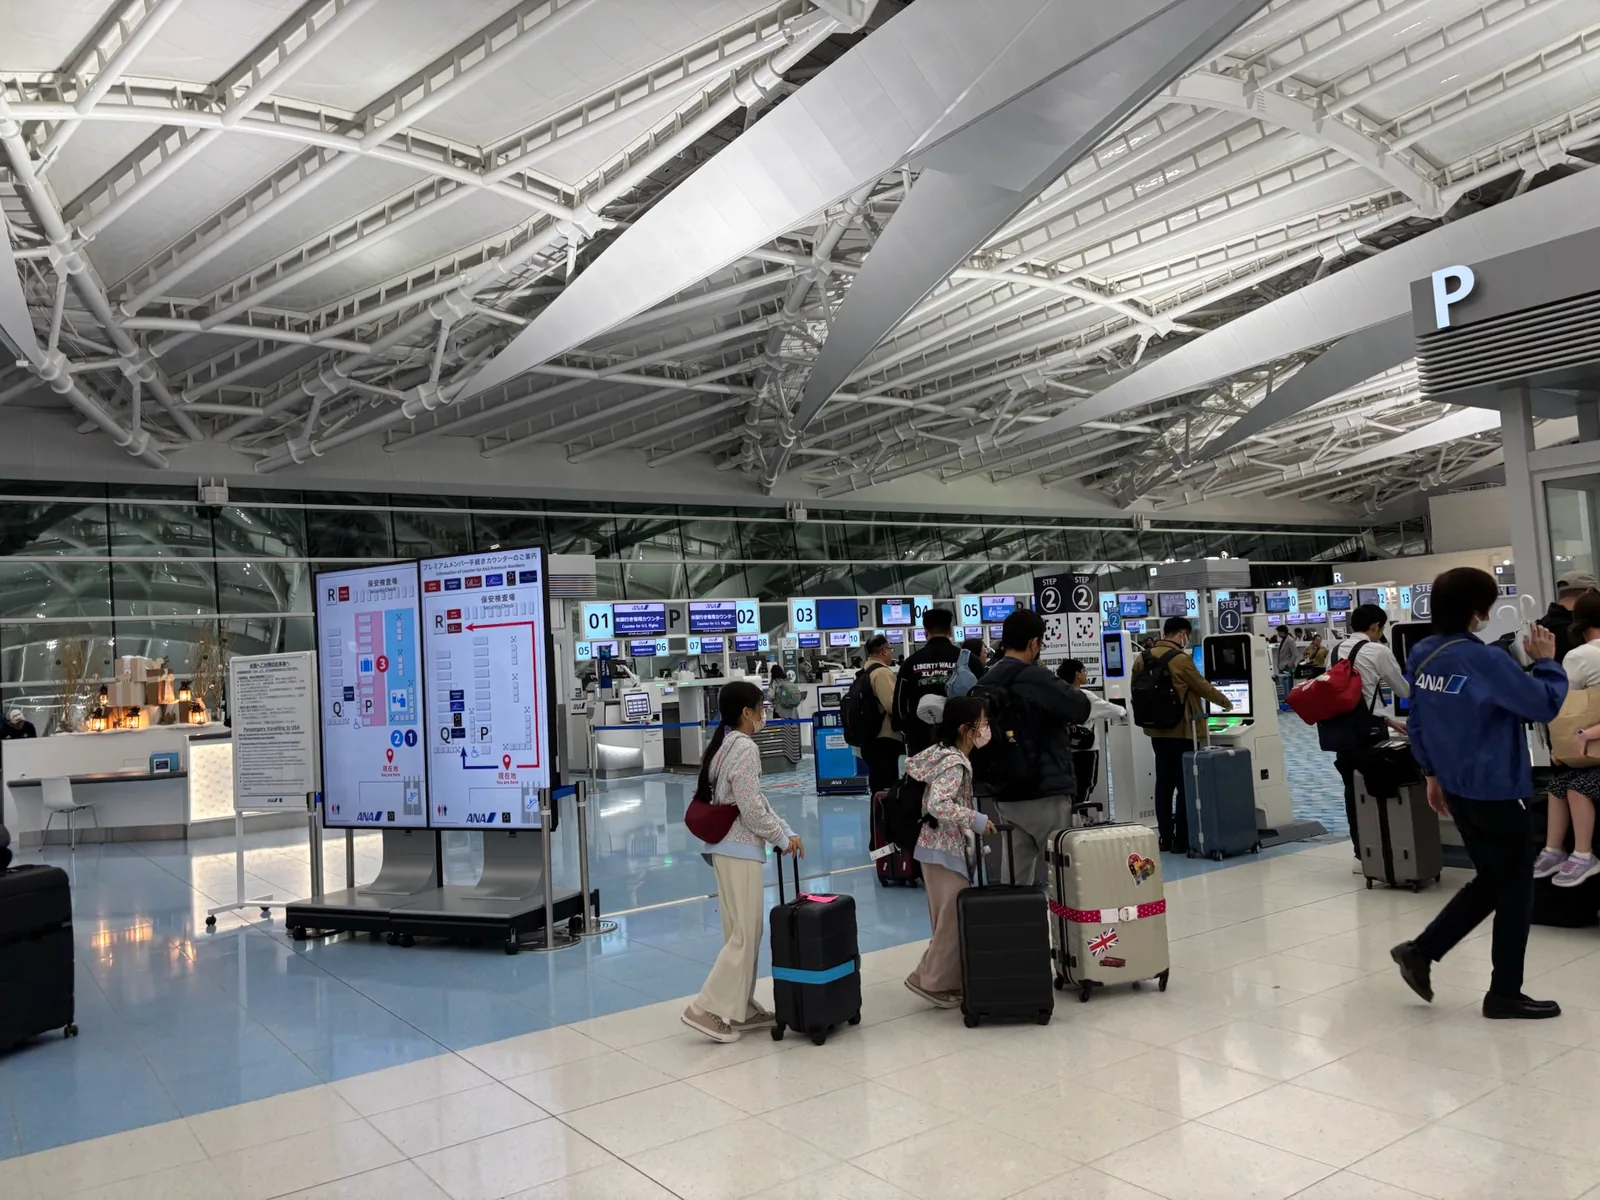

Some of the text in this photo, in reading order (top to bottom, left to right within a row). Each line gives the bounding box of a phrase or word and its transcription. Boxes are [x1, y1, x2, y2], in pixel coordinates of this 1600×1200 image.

[1432, 265, 1474, 329] P
[1042, 577, 1058, 587] STEP
[1074, 576, 1090, 584] STEP
[1333, 572, 1342, 583] R
[1415, 584, 1432, 592] STE
[328, 588, 335, 602] R
[1045, 590, 1057, 608] 2
[1077, 588, 1089, 606] 2
[1318, 595, 1326, 606] 11
[1402, 594, 1410, 603] 13
[1186, 599, 1196, 610] 08
[1221, 601, 1238, 609] STEP
[1420, 598, 1430, 614] 1
[796, 608, 813, 622] 03
[860, 605, 869, 622] P
[964, 604, 978, 617] 05
[435, 615, 444, 629] R
[589, 613, 609, 629] 01
[669, 609, 681, 628] P
[737, 609, 755, 624] 02
[1111, 615, 1118, 625] 2
[1225, 613, 1234, 629] 1
[758, 638, 768, 646] 08
[850, 634, 858, 642] 10
[578, 646, 590, 656] 05
[656, 642, 666, 652] 06
[689, 641, 700, 650] 07
[379, 659, 386, 669] 3
[913, 663, 938, 671] LIBERTY
[1415, 673, 1444, 692] ANA
[333, 702, 342, 717] Q
[365, 700, 372, 713] P
[394, 733, 400, 744] 2
[408, 733, 414, 744] 1
[440, 727, 450, 744] Q
[480, 727, 489, 741] P
[357, 812, 374, 821] ANA
[466, 813, 487, 823] ANA
